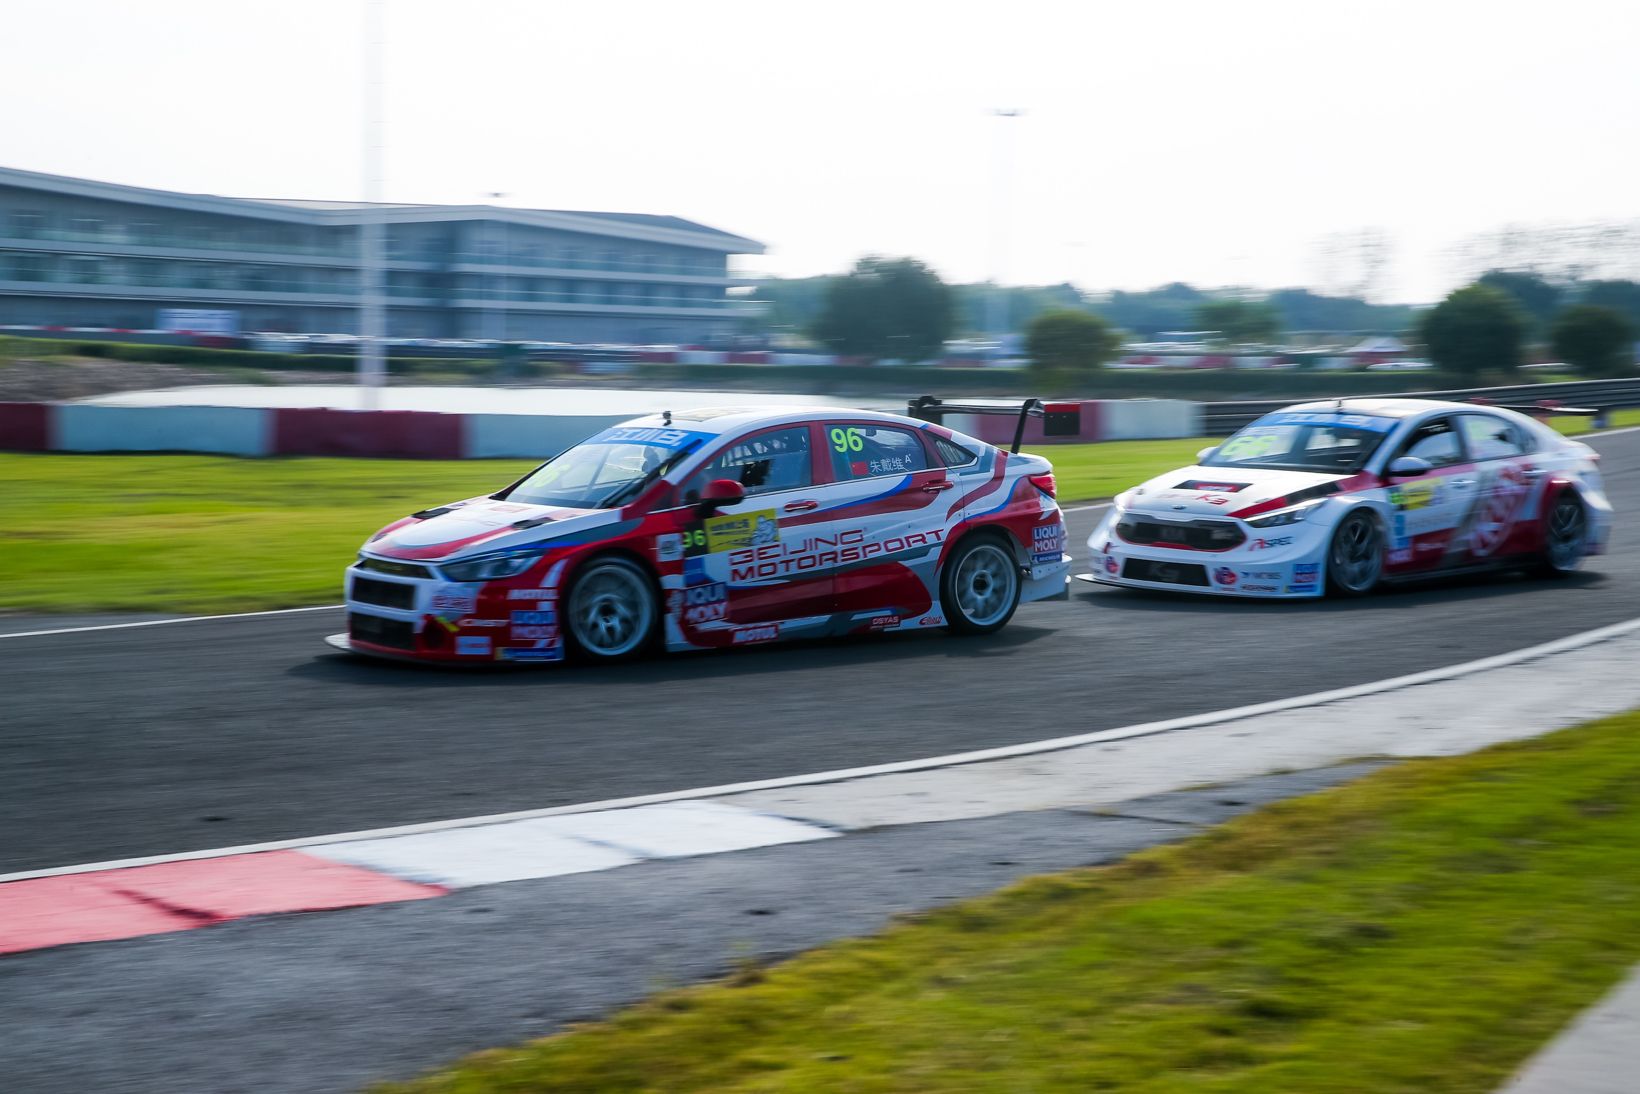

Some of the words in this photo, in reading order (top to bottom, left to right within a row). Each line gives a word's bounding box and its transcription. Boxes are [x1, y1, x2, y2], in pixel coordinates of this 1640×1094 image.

[831, 428, 863, 452] 96
[683, 530, 705, 548] 96
[1034, 526, 1058, 539] LIQUI
[730, 529, 865, 567] BEIJING
[1034, 539, 1058, 552] MOLY
[731, 529, 944, 582] MOTORSPORT
[734, 627, 778, 643] MOTUL
